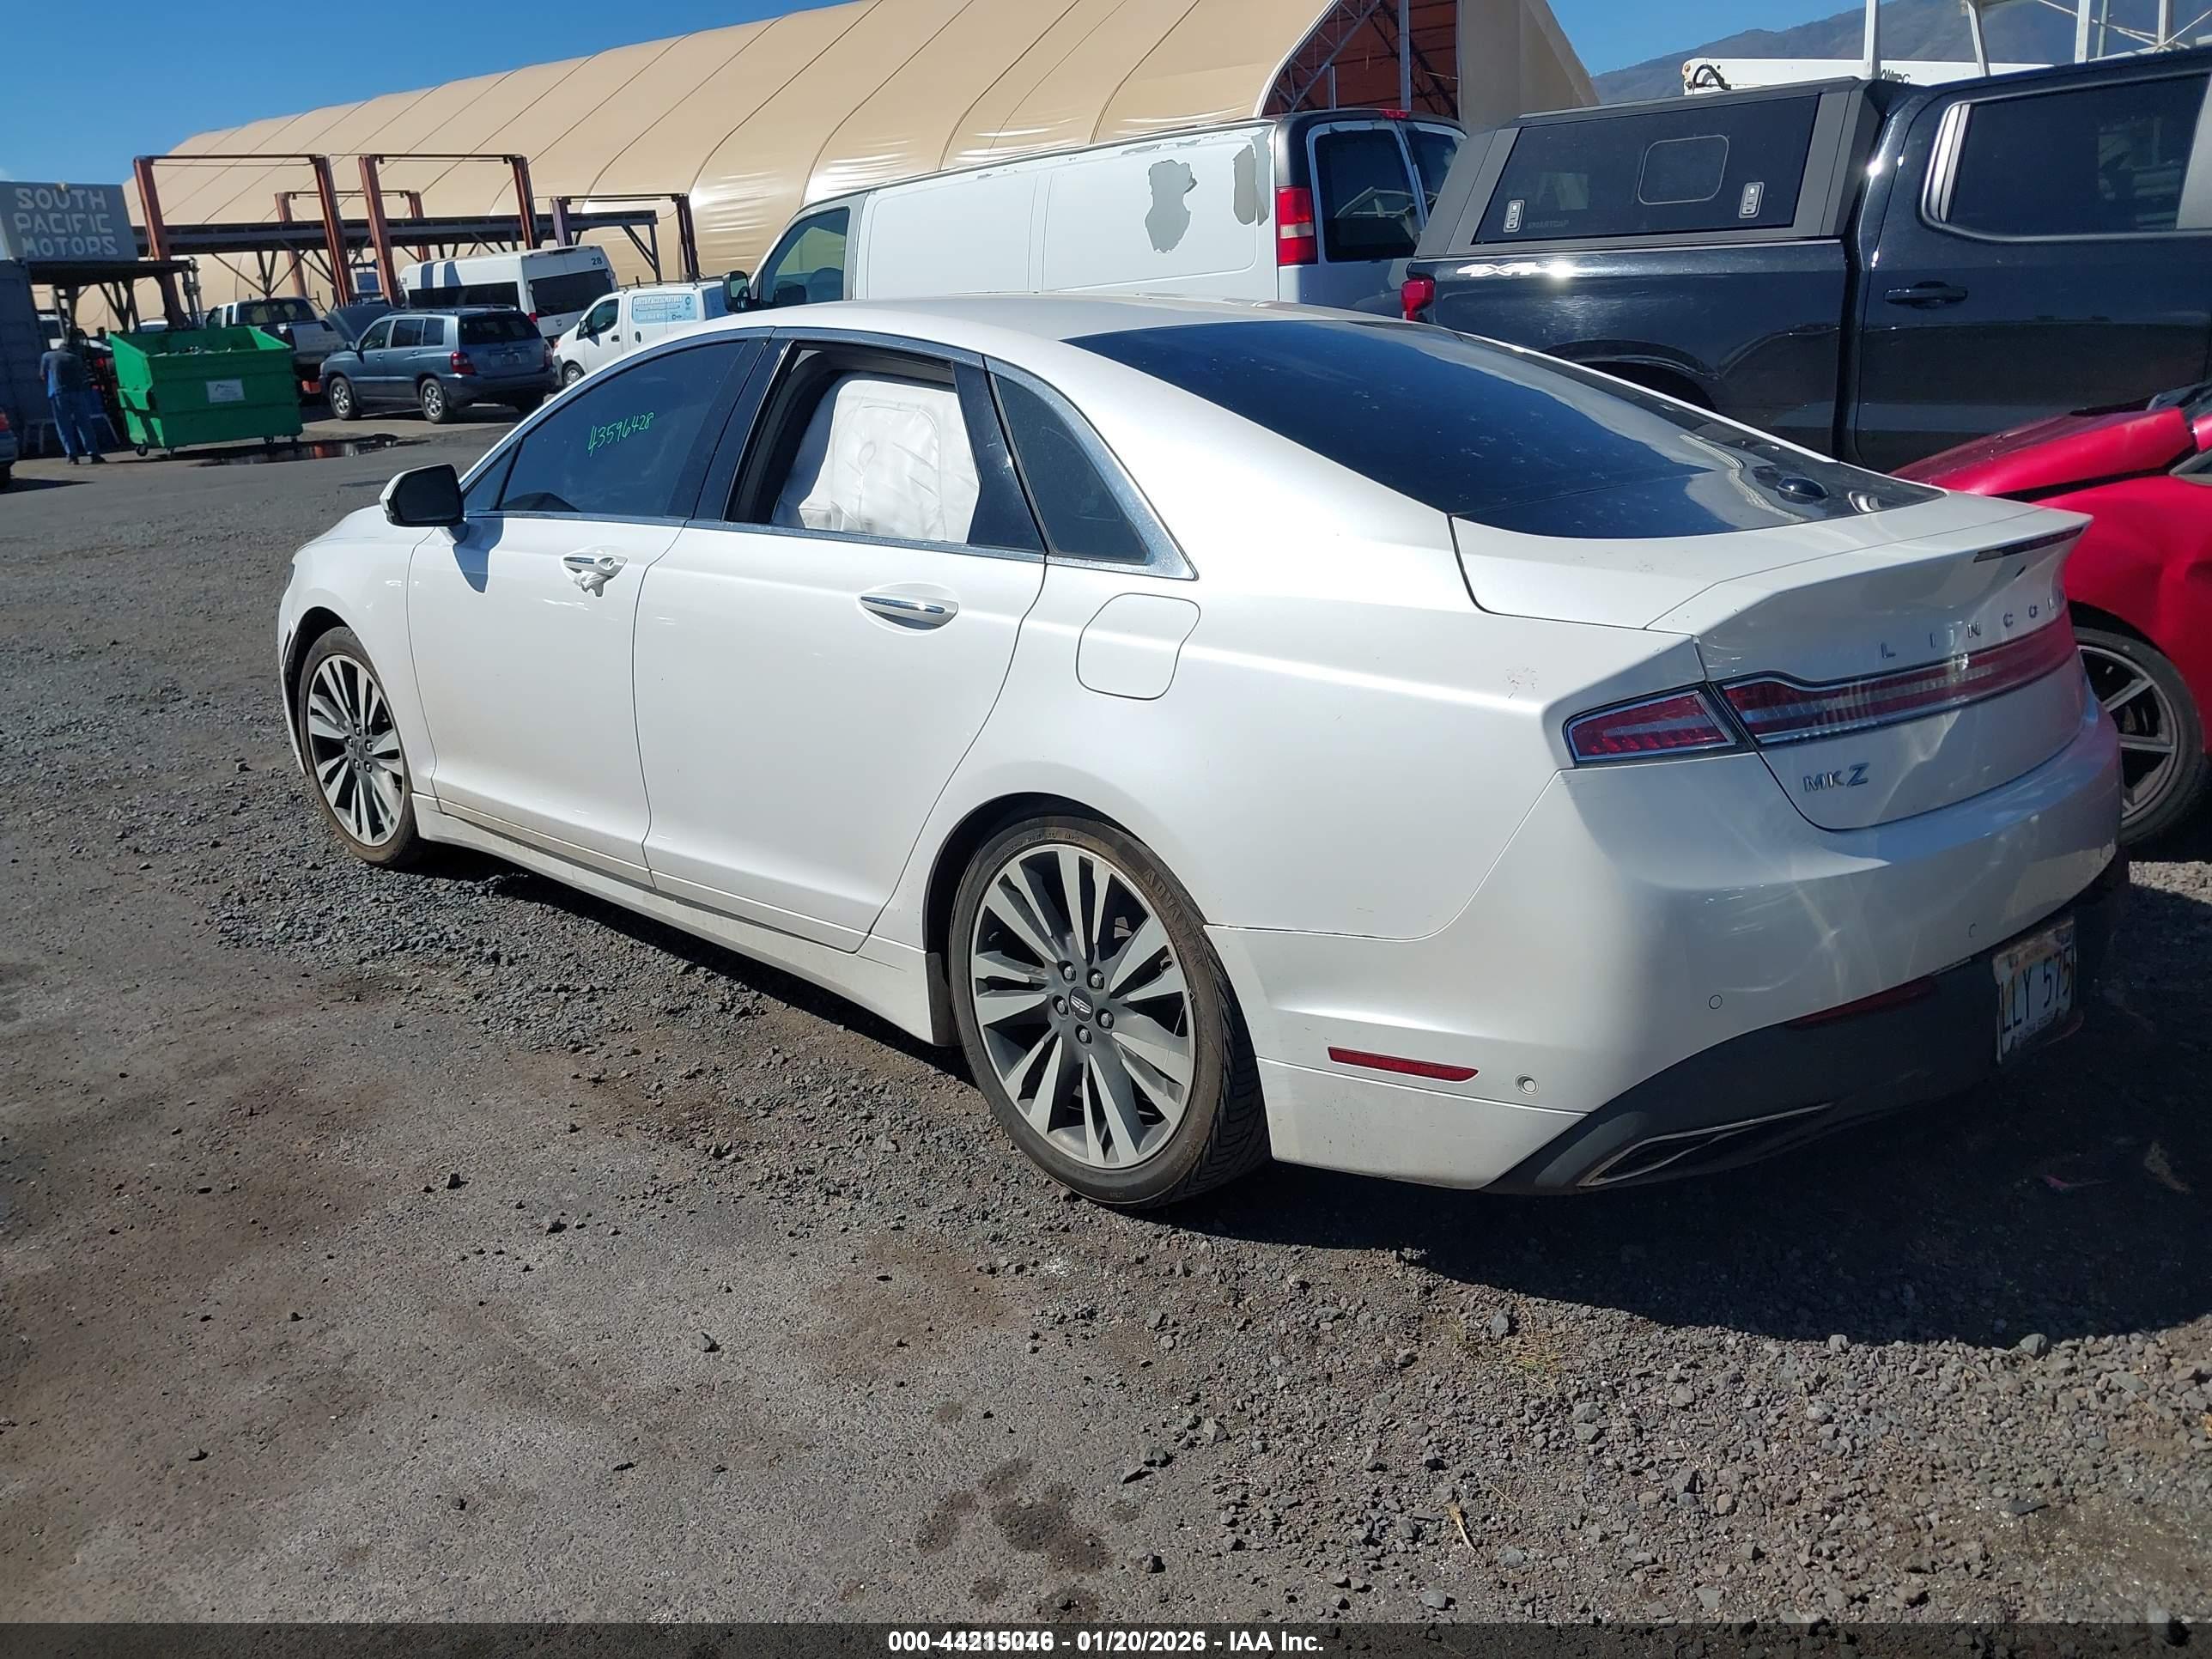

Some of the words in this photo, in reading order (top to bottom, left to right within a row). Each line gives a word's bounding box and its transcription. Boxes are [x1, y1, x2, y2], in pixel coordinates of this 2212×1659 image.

[15, 187, 107, 210] SOUTH
[13, 212, 113, 234] PACIFIC
[21, 235, 118, 258] MOTORS
[590, 257, 603, 265] 28
[587, 412, 654, 458] 43596428
[1802, 763, 1870, 793] MKZ
[2001, 967, 2032, 1033] LLY
